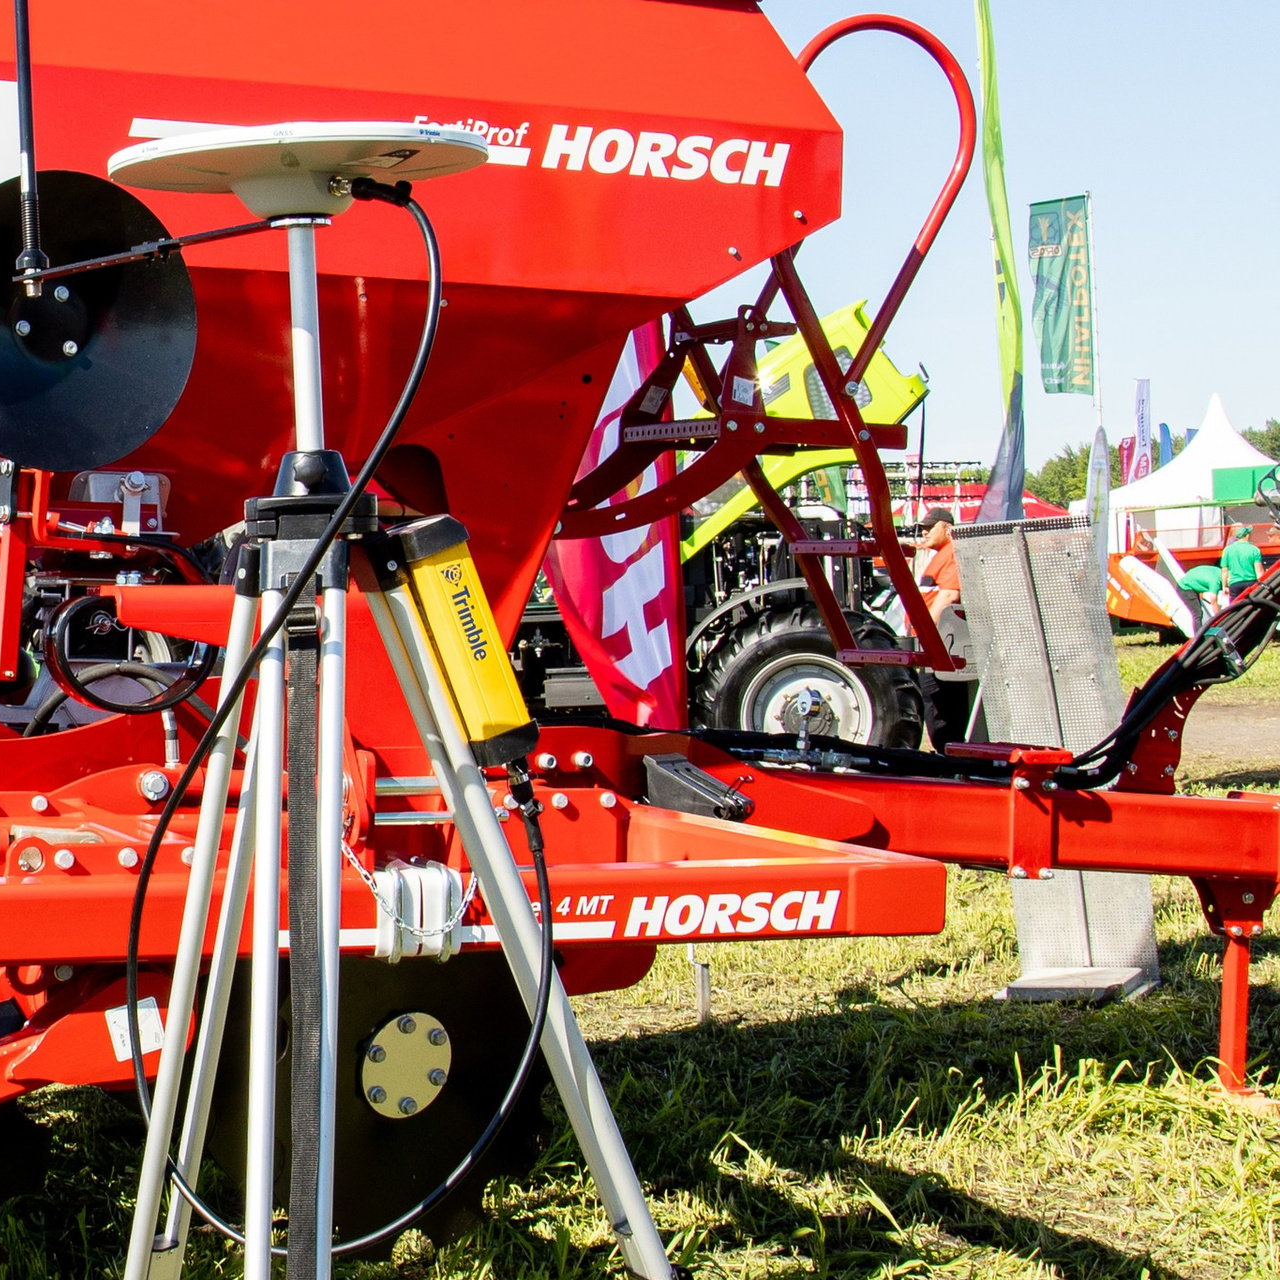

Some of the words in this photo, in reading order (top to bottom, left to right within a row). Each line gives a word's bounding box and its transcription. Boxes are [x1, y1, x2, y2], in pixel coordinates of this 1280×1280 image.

[541, 124, 791, 188] HORSCH
[452, 586, 487, 661] Trimble
[556, 896, 572, 916] 4
[575, 894, 614, 916] MT
[623, 889, 841, 937] HORSCH
